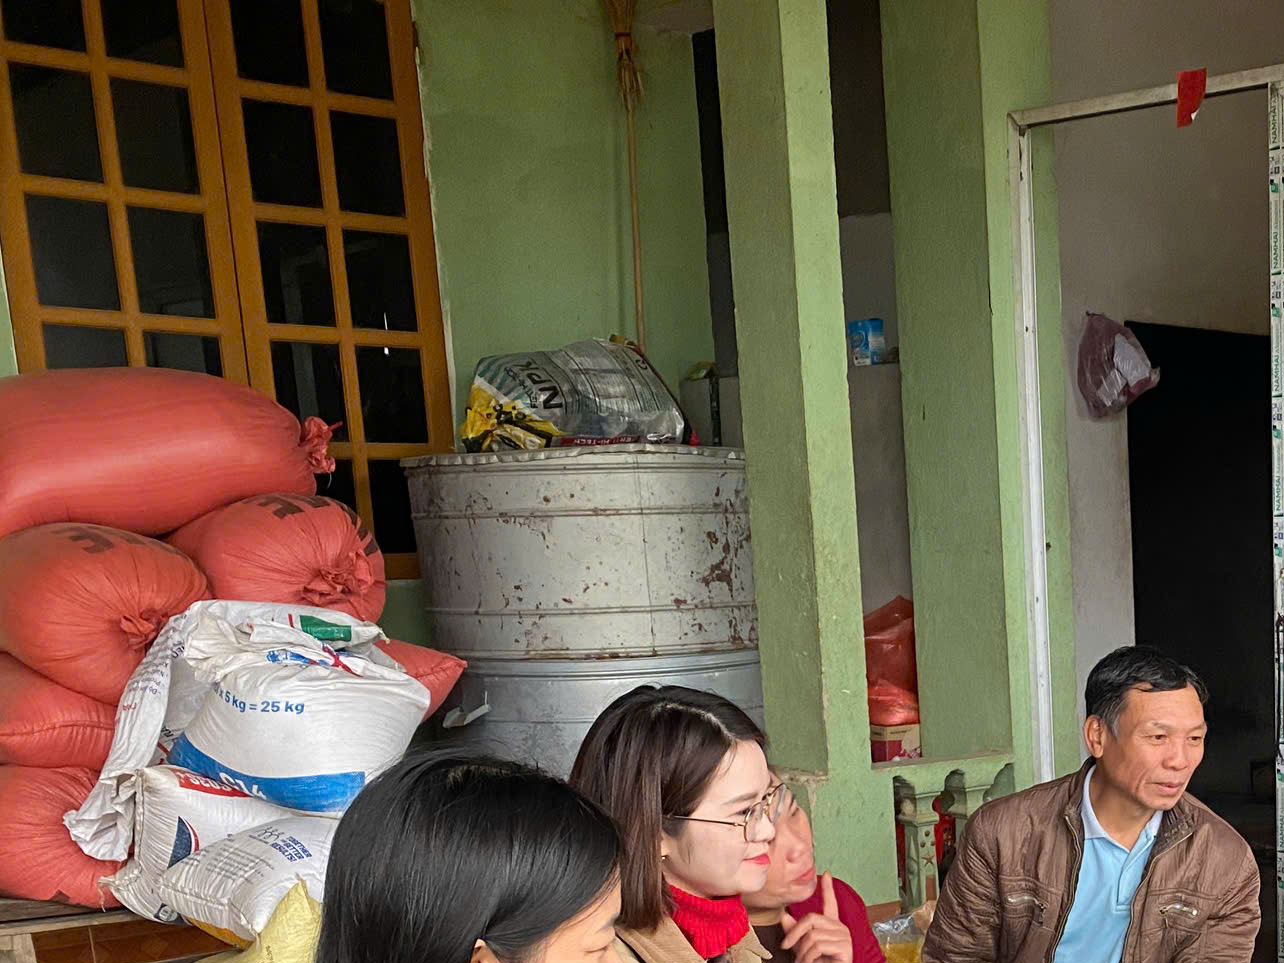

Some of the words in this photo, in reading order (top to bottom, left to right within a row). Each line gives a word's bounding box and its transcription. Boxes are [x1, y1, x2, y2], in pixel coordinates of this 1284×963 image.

[224, 691, 231, 703] 5
[232, 695, 246, 713] kg
[260, 701, 281, 713] 25
[284, 700, 305, 715] kg
